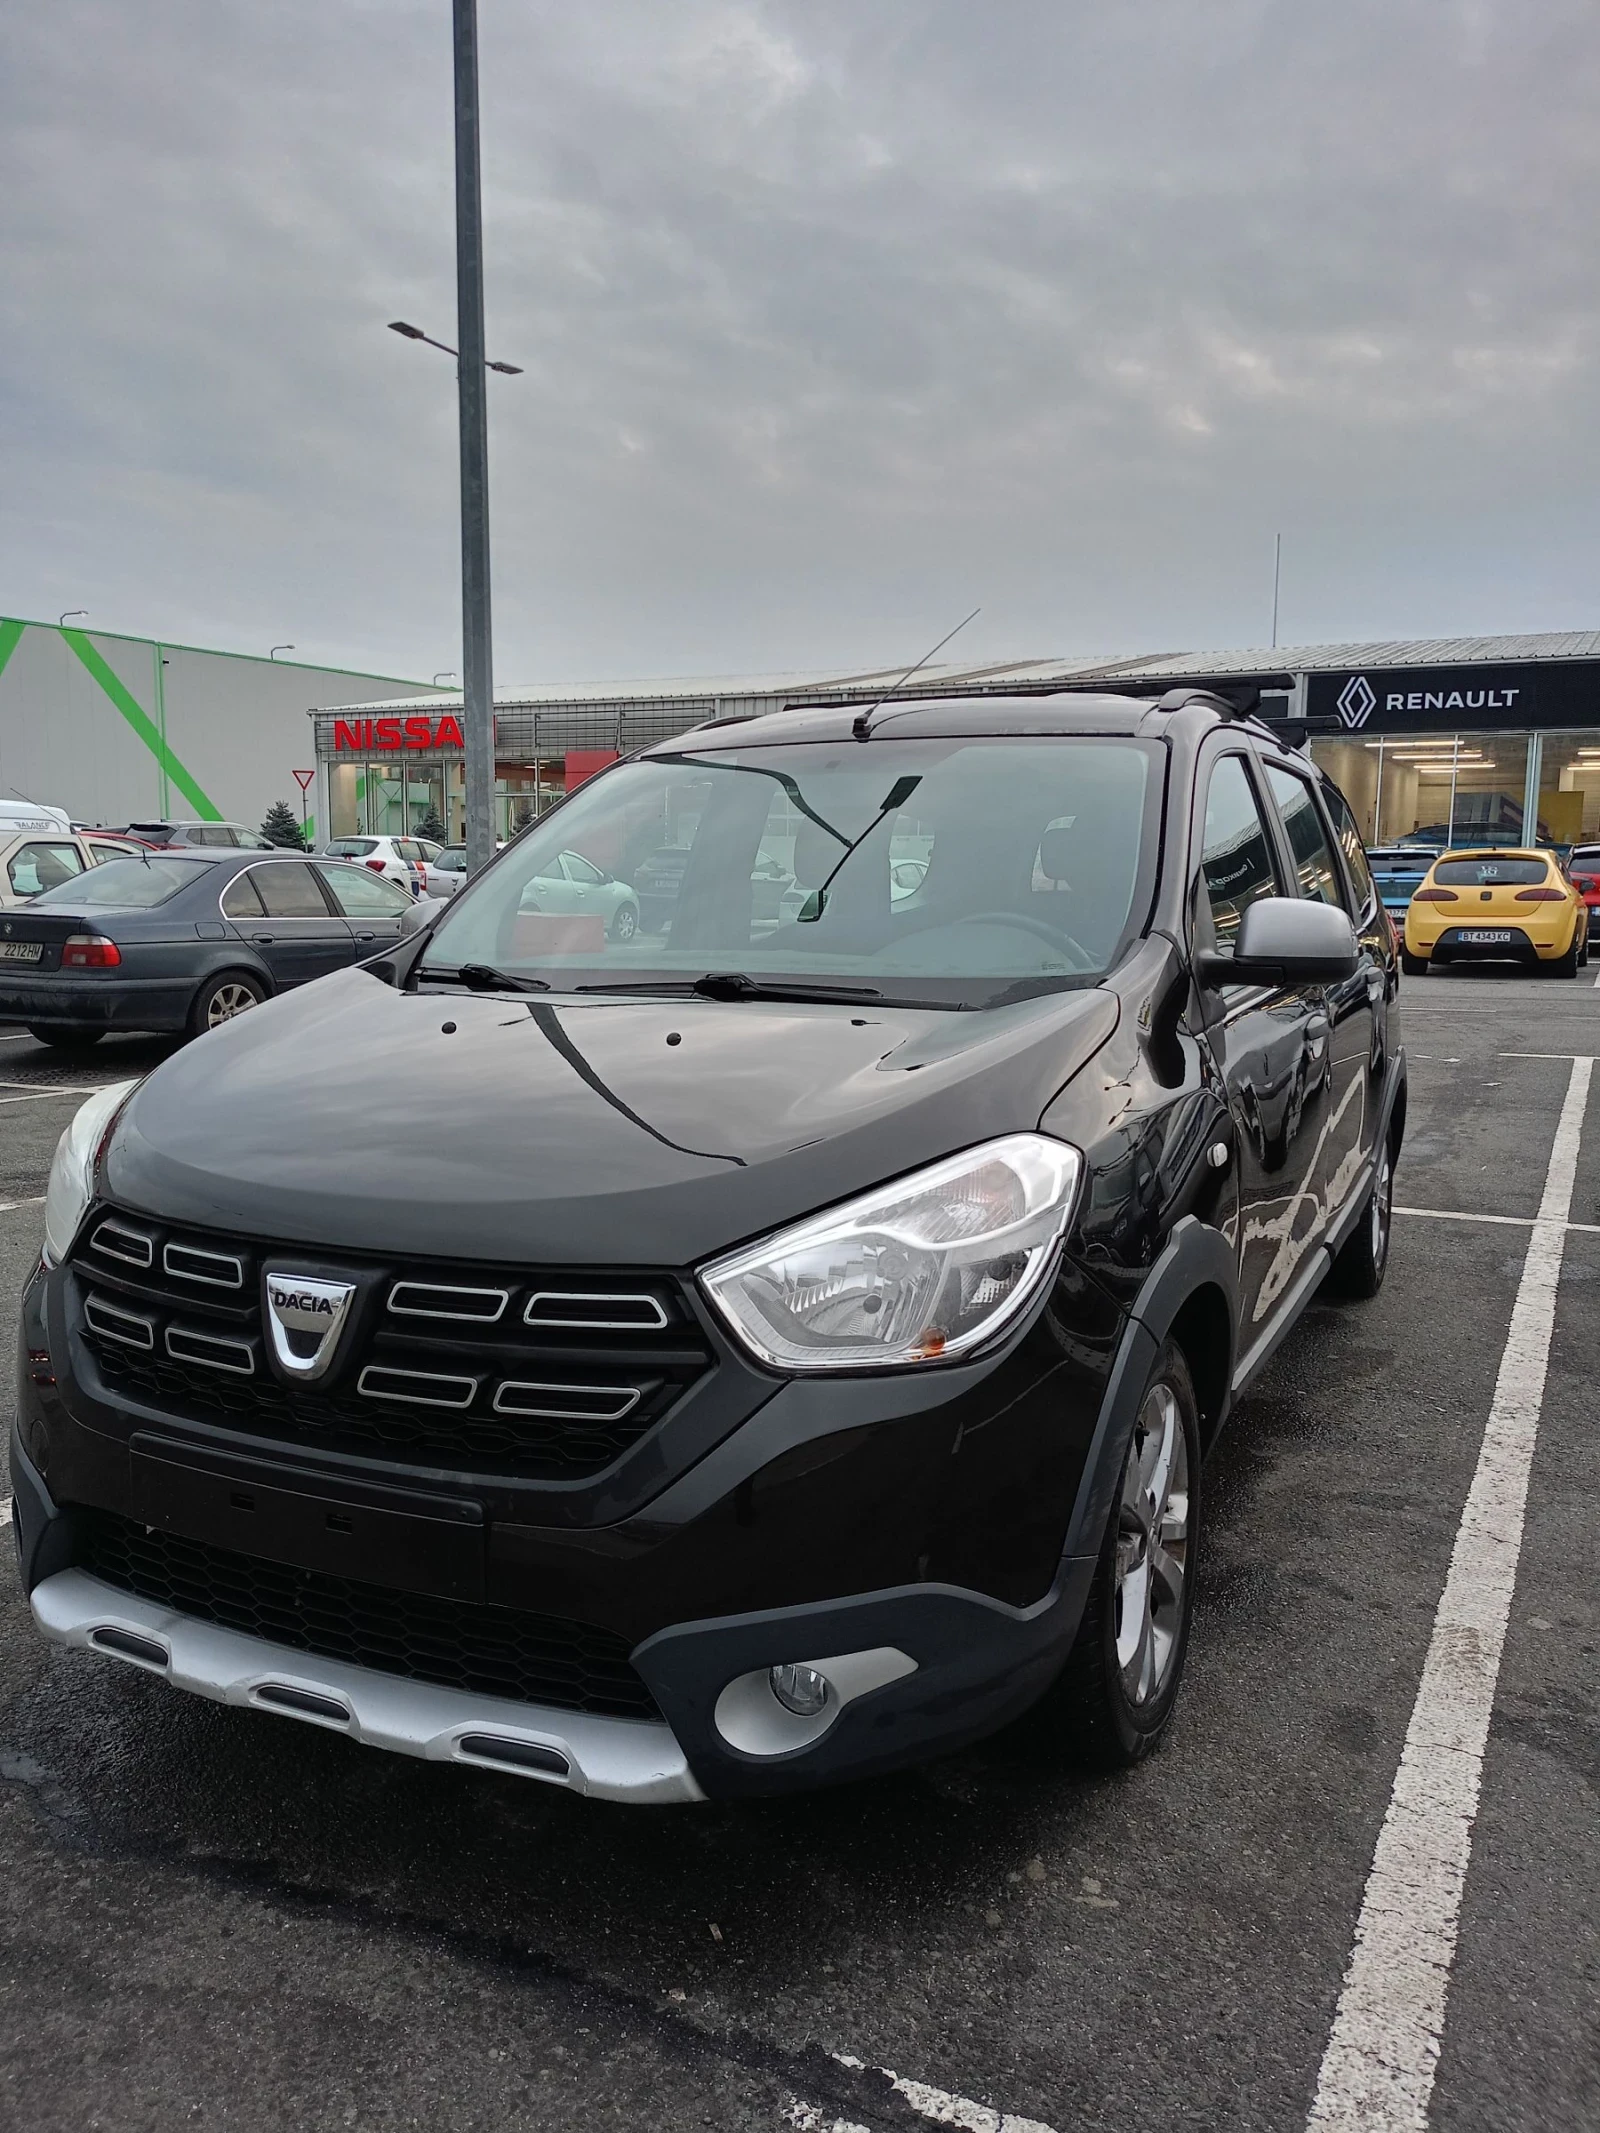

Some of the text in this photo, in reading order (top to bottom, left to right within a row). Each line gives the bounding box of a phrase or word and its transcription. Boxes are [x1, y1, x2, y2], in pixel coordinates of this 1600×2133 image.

[1386, 689, 1519, 710] RENAULT
[334, 715, 497, 751] NISSA
[274, 1291, 333, 1315] DACIA
